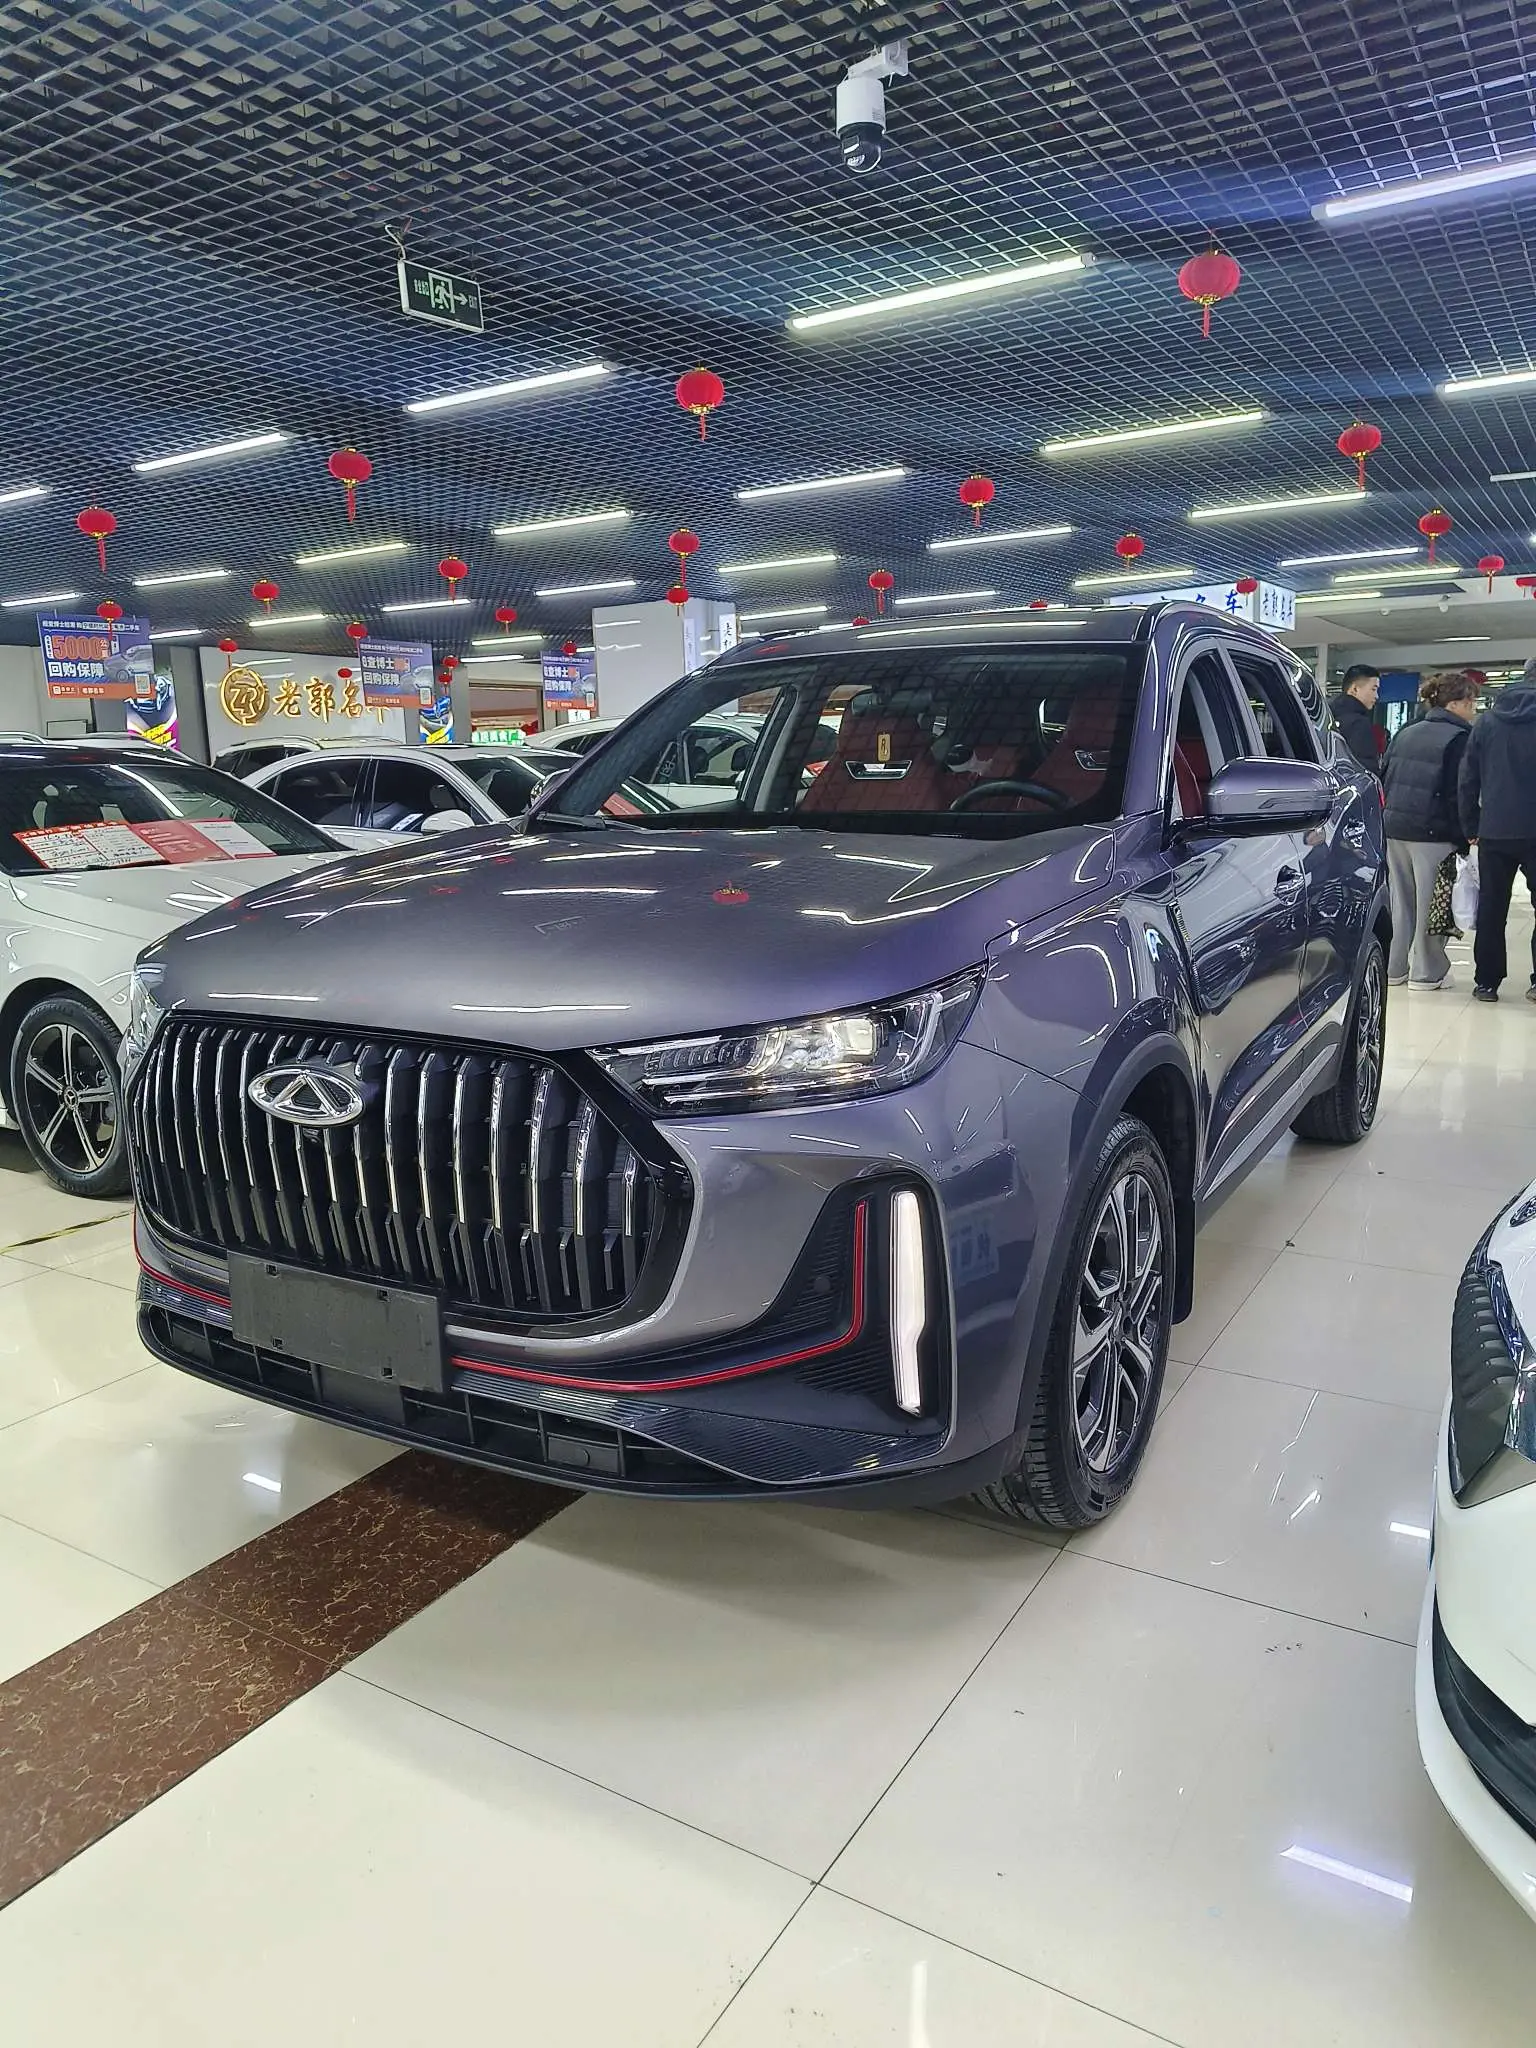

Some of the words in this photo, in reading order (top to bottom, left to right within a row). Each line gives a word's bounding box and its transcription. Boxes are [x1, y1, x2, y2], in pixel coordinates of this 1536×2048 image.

[52, 635, 102, 660] 5000
[47, 661, 105, 677] 回购保障
[363, 671, 400, 686] 回购保障
